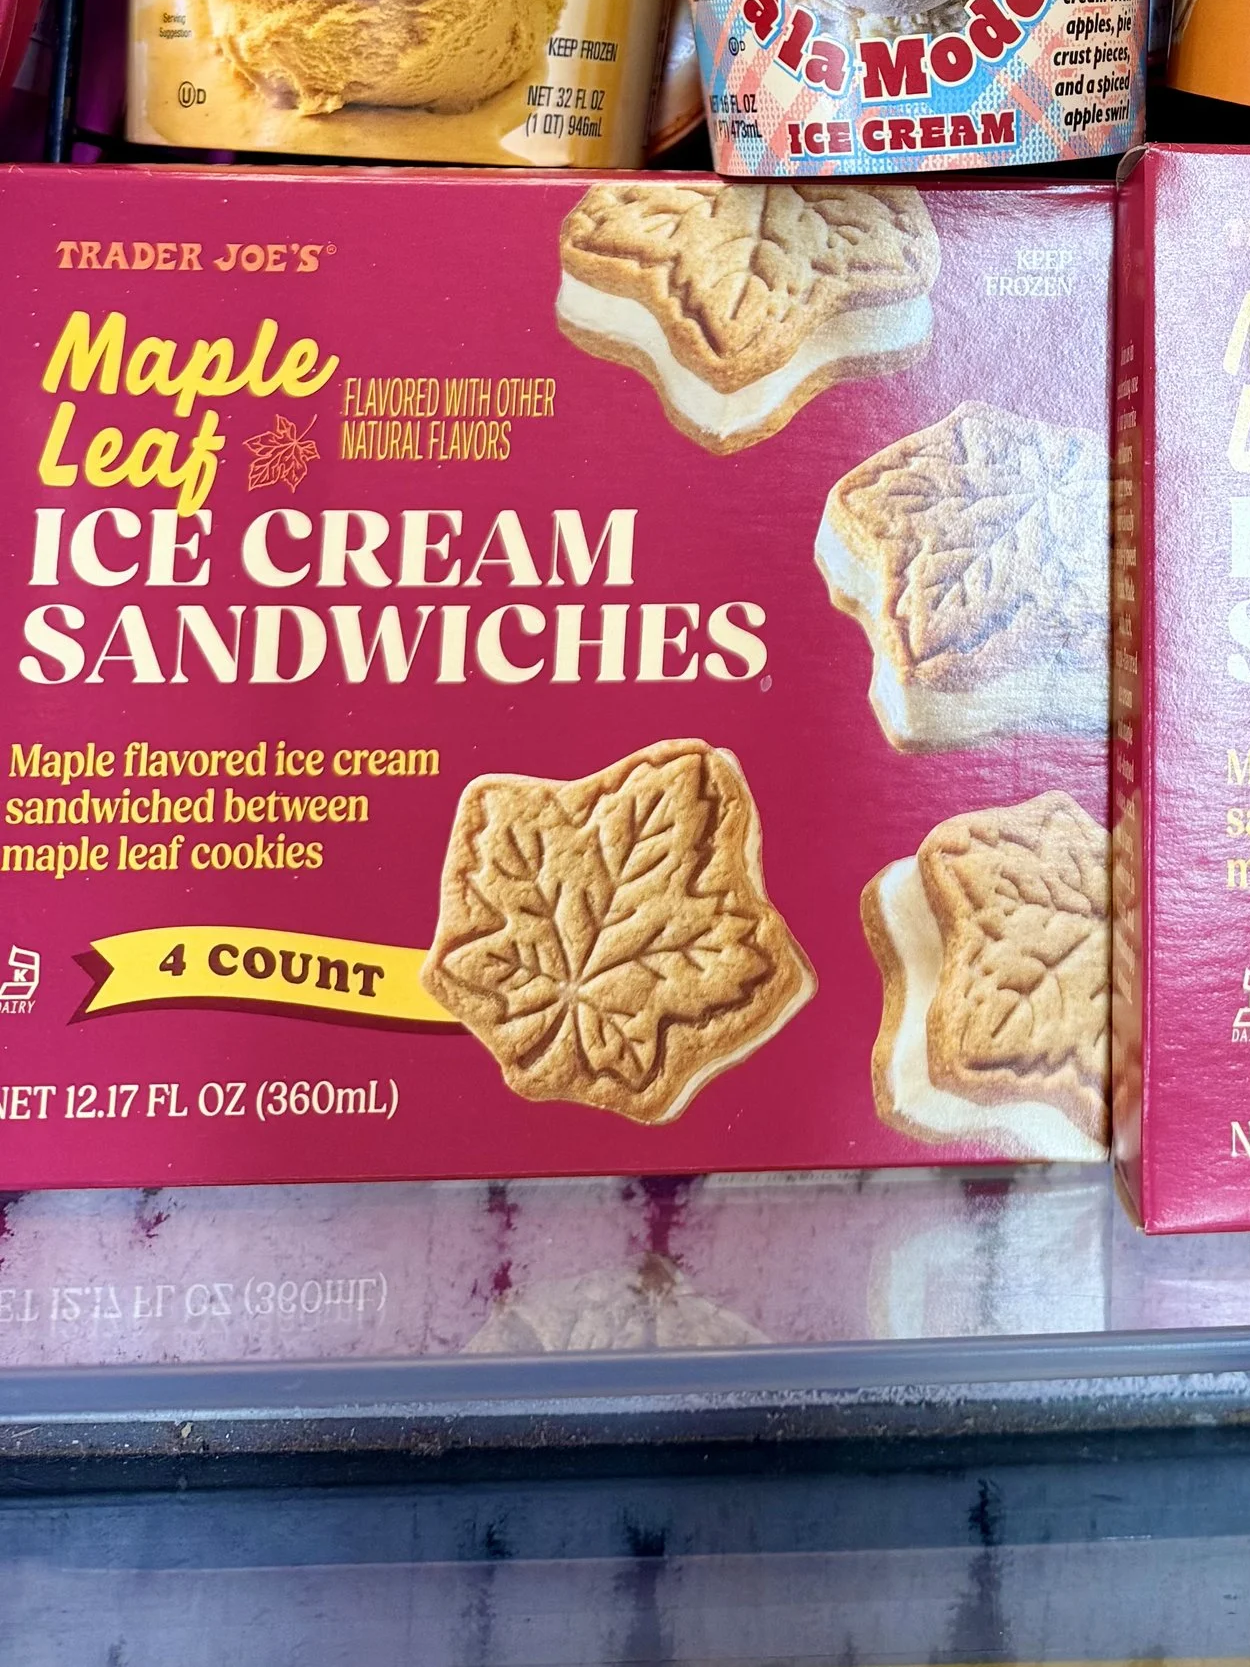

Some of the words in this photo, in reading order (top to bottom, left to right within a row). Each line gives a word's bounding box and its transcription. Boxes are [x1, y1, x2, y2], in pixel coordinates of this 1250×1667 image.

[1066, 13, 1115, 40] apples,
[1116, 13, 1132, 37] pie
[548, 38, 577, 58] KEEP
[581, 41, 617, 63] FROZEN
[778, 13, 848, 93] la
[1053, 47, 1090, 66] crust
[1092, 44, 1130, 68] pieces,
[527, 85, 553, 107] NET
[557, 87, 573, 108] 32
[575, 88, 588, 109] FL
[591, 90, 605, 110] OZ
[1055, 75, 1082, 96] and
[1086, 81, 1094, 95] a
[1096, 70, 1130, 97] spiced
[543, 114, 564, 139] QT)
[568, 116, 602, 137] 946mL
[787, 121, 852, 154] ICE
[860, 110, 1016, 151] CREAM
[1064, 105, 1103, 131] apple
[1105, 101, 1130, 123] swirl
[56, 240, 204, 272] TRADER
[1016, 250, 1074, 272] KEEP
[986, 275, 1074, 297] FROZEN
[41, 310, 341, 417] Maple
[344, 377, 441, 417] FLAVORED
[446, 378, 491, 415] WITH
[497, 378, 556, 416] OTHER
[341, 420, 422, 460] NATURAL
[428, 421, 511, 460] FLAVORS
[39, 401, 225, 517] Leaf
[28, 507, 213, 587] ICE
[242, 508, 639, 589] CREAM
[19, 601, 768, 686] SANDWICHES
[8, 742, 118, 784] Maple
[124, 741, 268, 777] flavored
[274, 742, 327, 776] ice
[332, 749, 440, 776] cream
[5, 788, 215, 825] sandwiched
[223, 789, 369, 823] between
[0, 837, 109, 879] maple
[117, 835, 184, 871] leaf
[190, 835, 324, 871] cookies
[158, 944, 186, 976] 4
[65, 1083, 136, 1119] 12.17
[145, 1082, 188, 1118] FL
[199, 1081, 245, 1117] OZ
[255, 1078, 400, 1120] (360mL)
